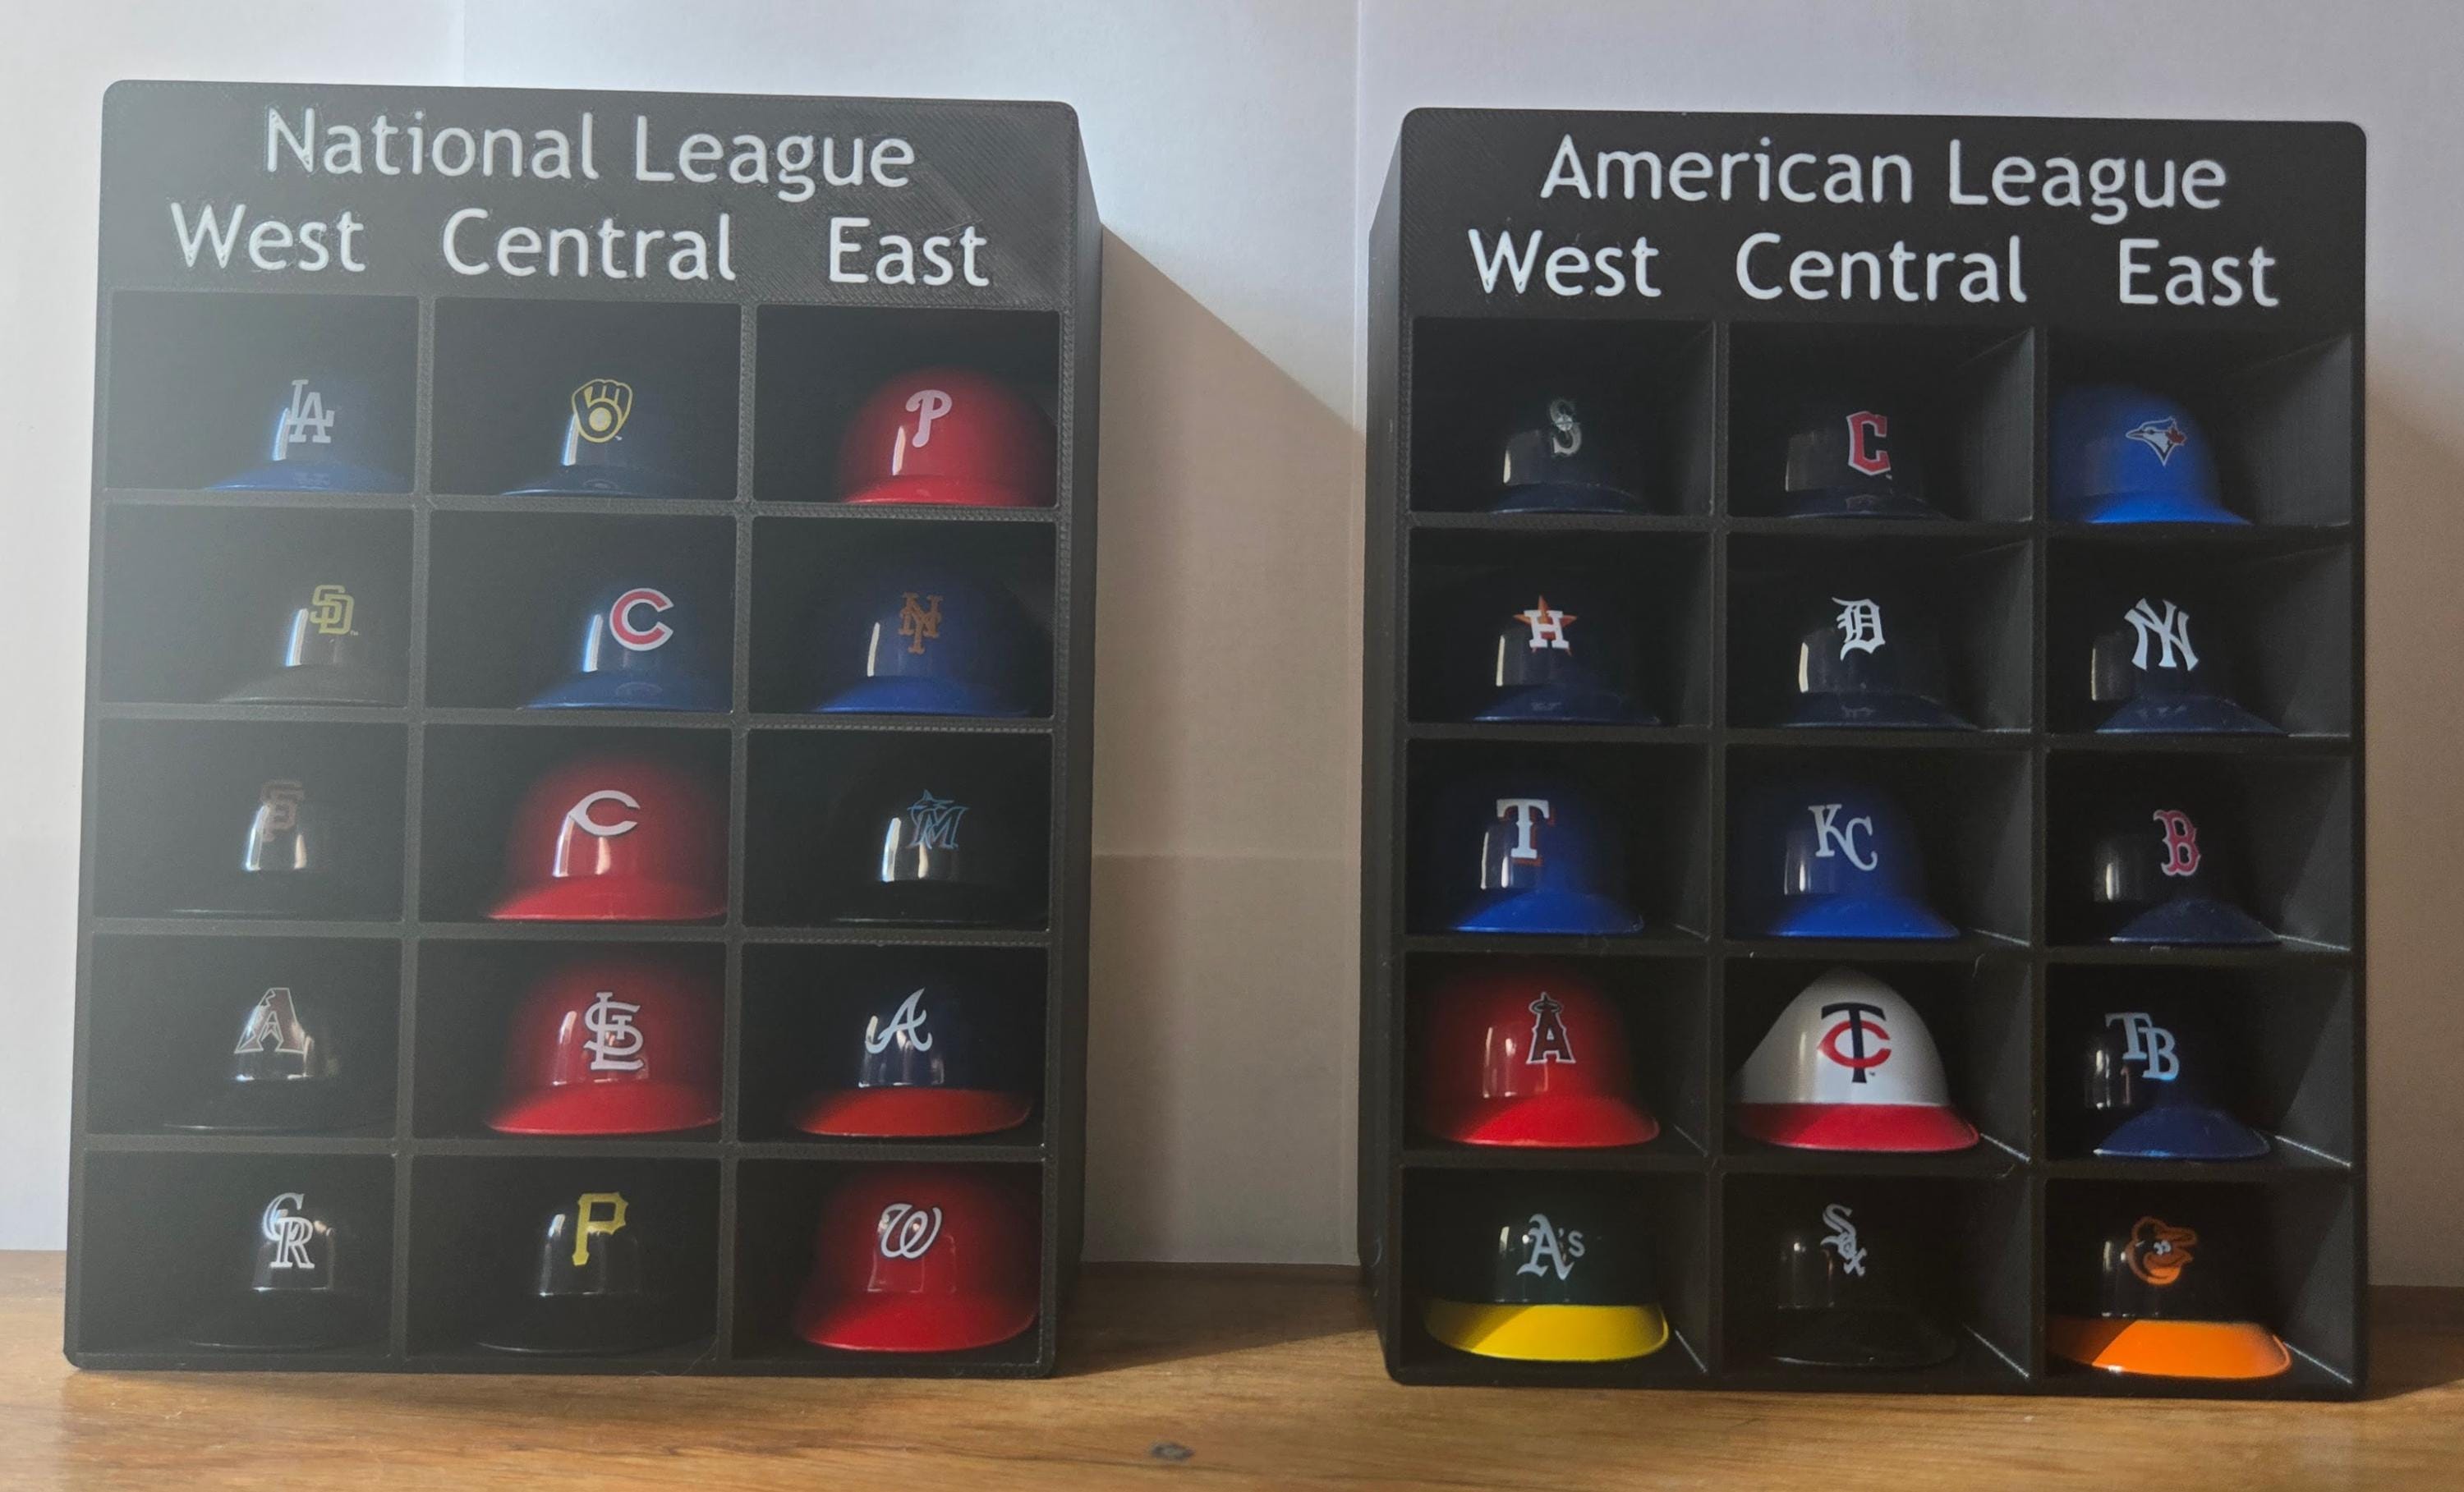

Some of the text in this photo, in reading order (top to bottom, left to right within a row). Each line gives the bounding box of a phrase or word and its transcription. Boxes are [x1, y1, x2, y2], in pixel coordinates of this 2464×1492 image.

[264, 105, 915, 203] National League
[1540, 133, 2229, 226] American League
[168, 201, 367, 274] West
[441, 208, 737, 282] Central
[826, 217, 991, 290] East
[1466, 228, 1662, 299] West
[1735, 232, 2029, 305] Central
[2117, 238, 2279, 309] East
[285, 379, 335, 443] LA
[905, 388, 953, 448] P
[1846, 411, 1891, 476] C
[310, 584, 354, 635] SD
[609, 587, 674, 651] C
[1523, 608, 1570, 650] H
[1831, 596, 1886, 661] D
[2124, 598, 2199, 671] NY
[573, 789, 641, 838] C
[1496, 797, 1555, 865] T
[1808, 802, 1878, 872] KC
[2153, 809, 2202, 878] B
[234, 987, 307, 1054] A
[864, 987, 933, 1054] A
[1525, 991, 1576, 1065] A
[2104, 1012, 2181, 1081] TB
[572, 1191, 629, 1266] P
[876, 1202, 943, 1260] W
[1515, 1213, 1586, 1281] A's
